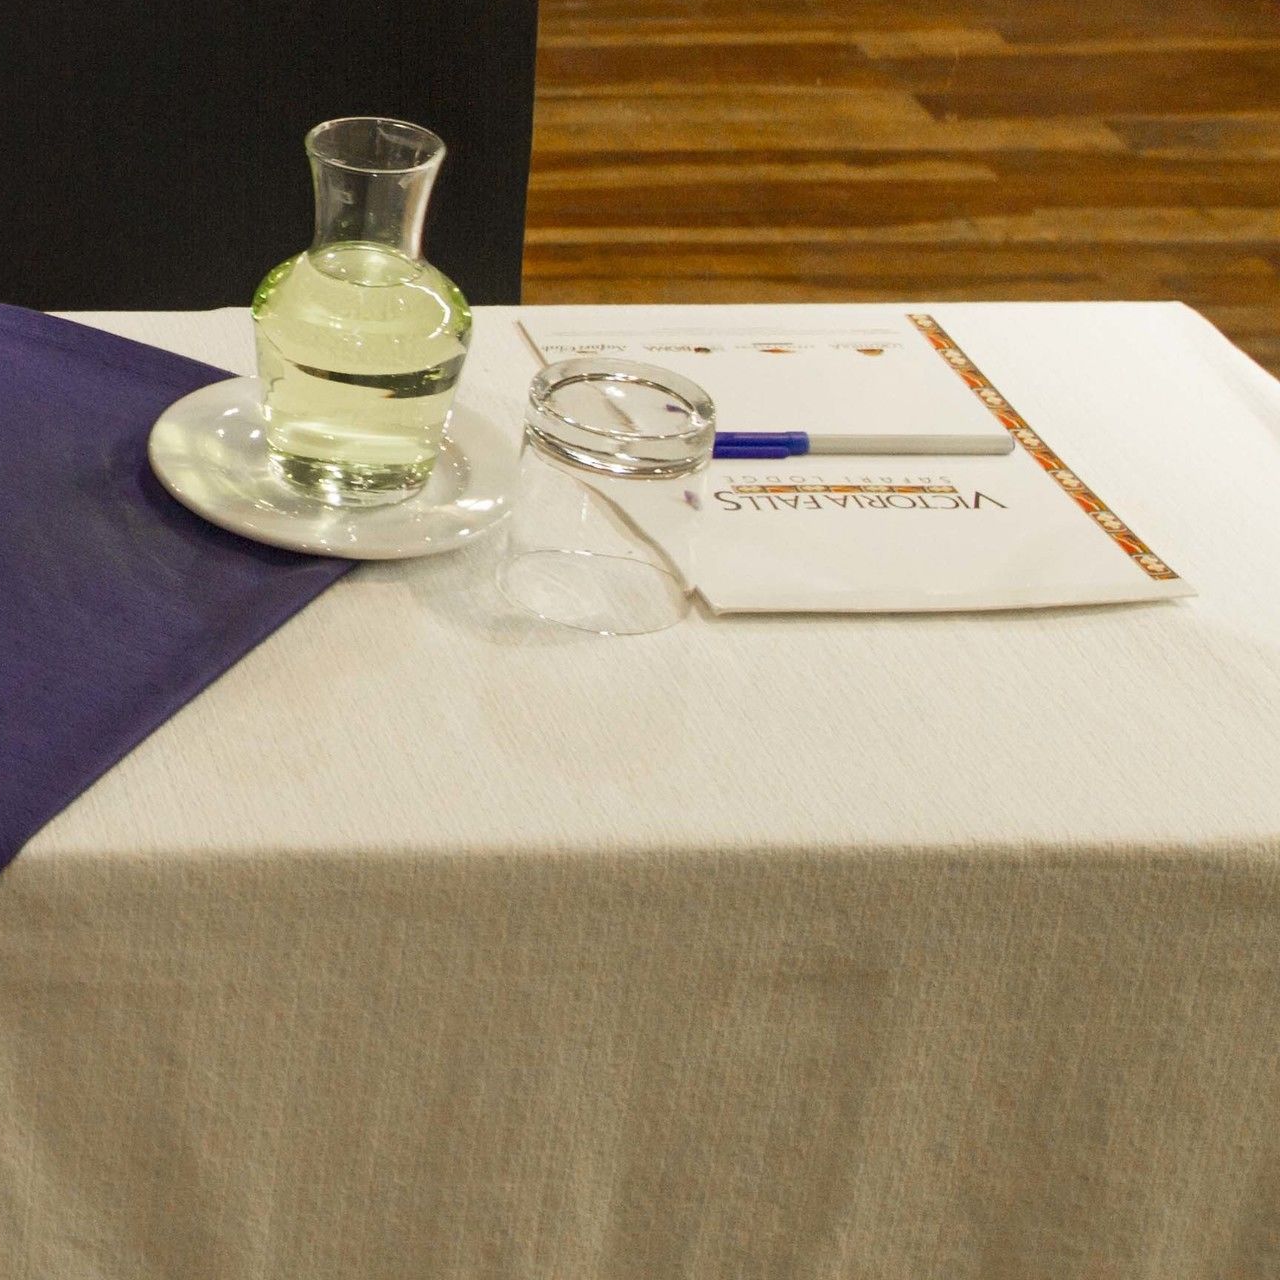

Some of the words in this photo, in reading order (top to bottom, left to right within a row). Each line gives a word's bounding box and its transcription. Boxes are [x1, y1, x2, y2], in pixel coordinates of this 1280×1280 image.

[723, 475, 825, 483] LODGE
[844, 475, 952, 484] SAFARI
[713, 491, 822, 511] FALLS
[827, 490, 1009, 510] VICTORIA
